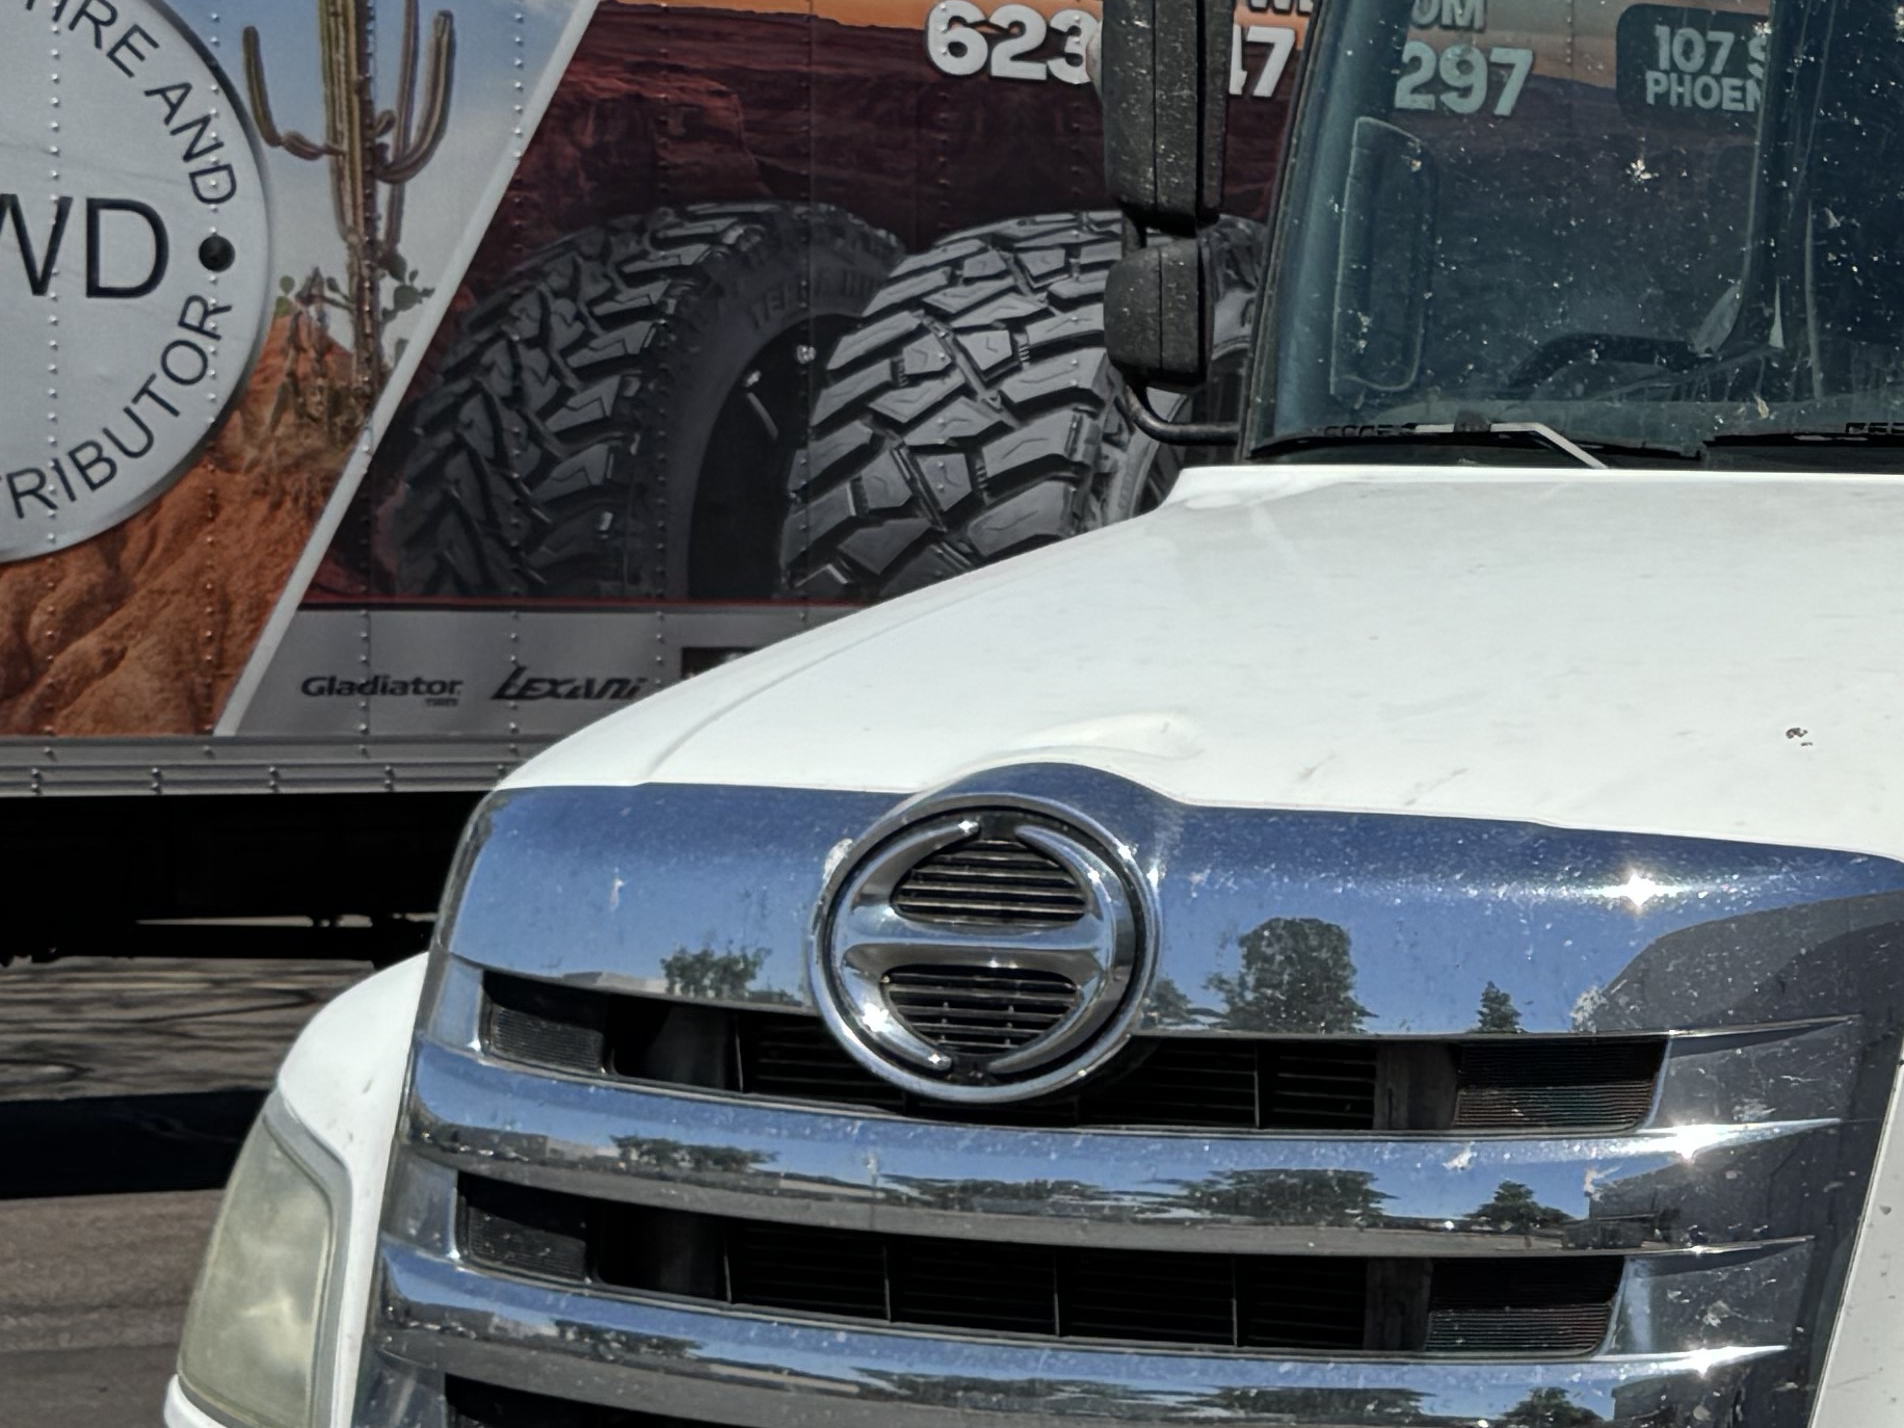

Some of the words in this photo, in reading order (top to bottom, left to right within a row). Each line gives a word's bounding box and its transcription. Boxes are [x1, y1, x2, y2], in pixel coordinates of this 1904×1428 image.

[1655, 24, 1735, 75] 107
[1646, 70, 1765, 112] PHOEN
[143, 81, 237, 206] AND
[0, 293, 233, 520] RIBUTOR
[301, 674, 464, 698] Gladiator
